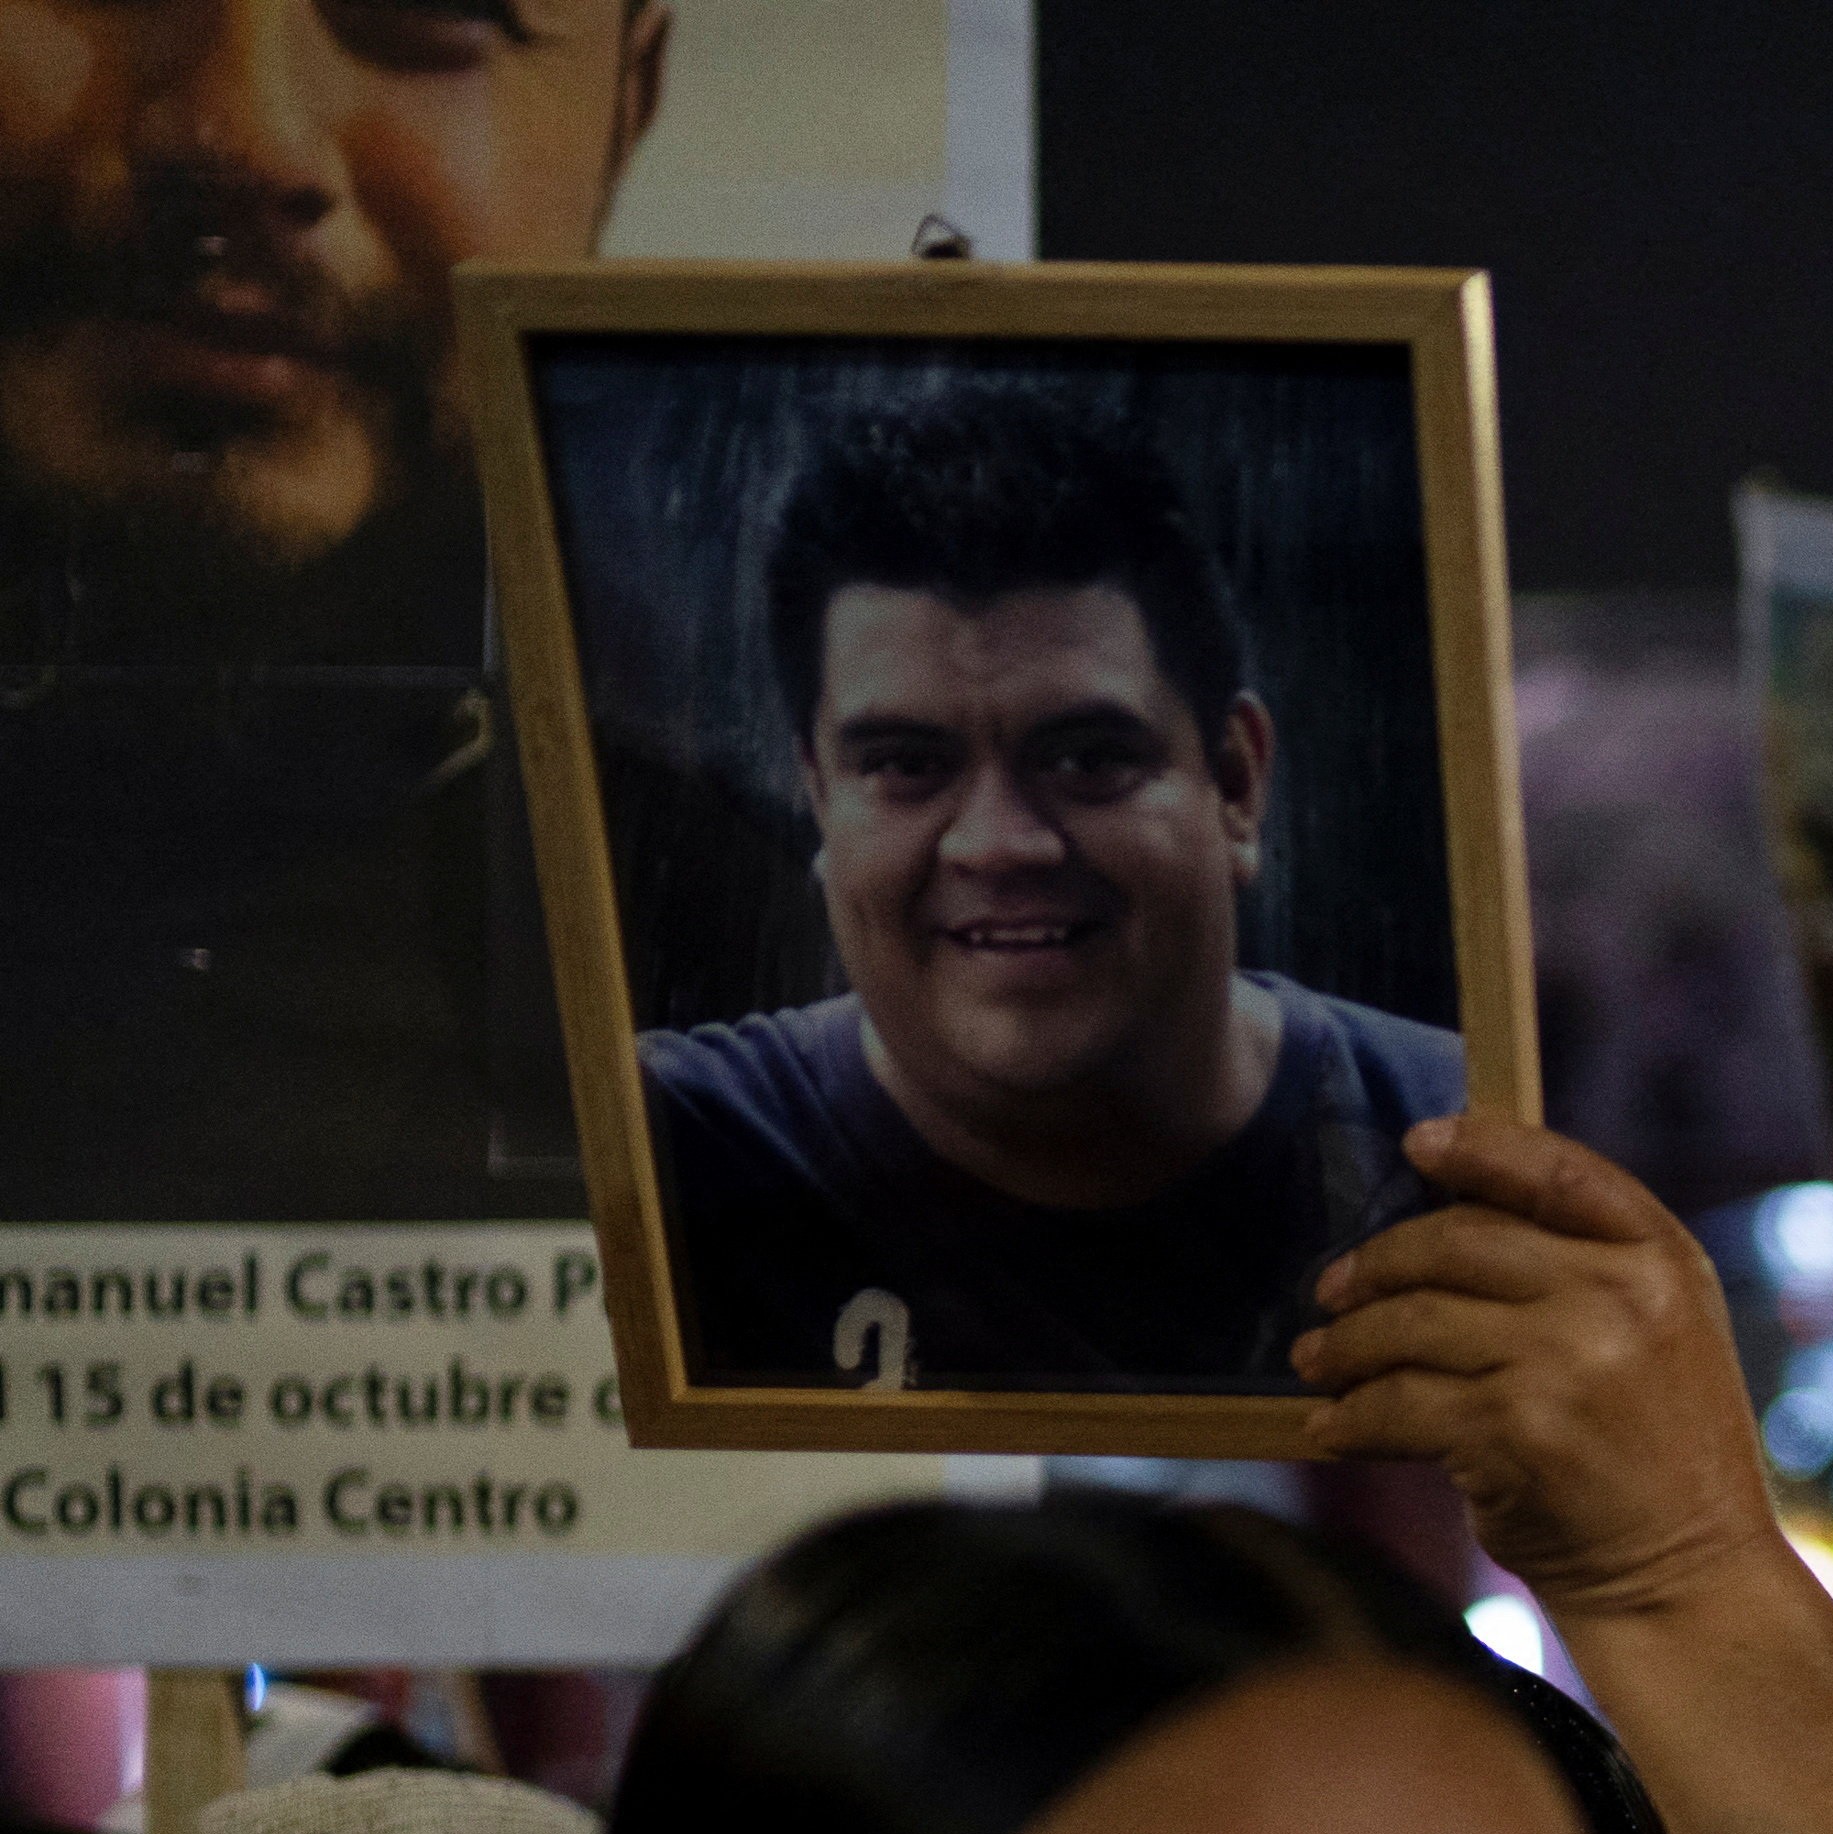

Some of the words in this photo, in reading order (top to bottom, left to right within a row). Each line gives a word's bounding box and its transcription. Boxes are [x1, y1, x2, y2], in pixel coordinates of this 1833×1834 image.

[286, 1250, 530, 1318] Castro
[38, 1360, 124, 1426] 15
[150, 1356, 245, 1426] de
[269, 1356, 570, 1426] octubre
[1, 1464, 299, 1536] Colonia
[323, 1468, 579, 1536] Centro
